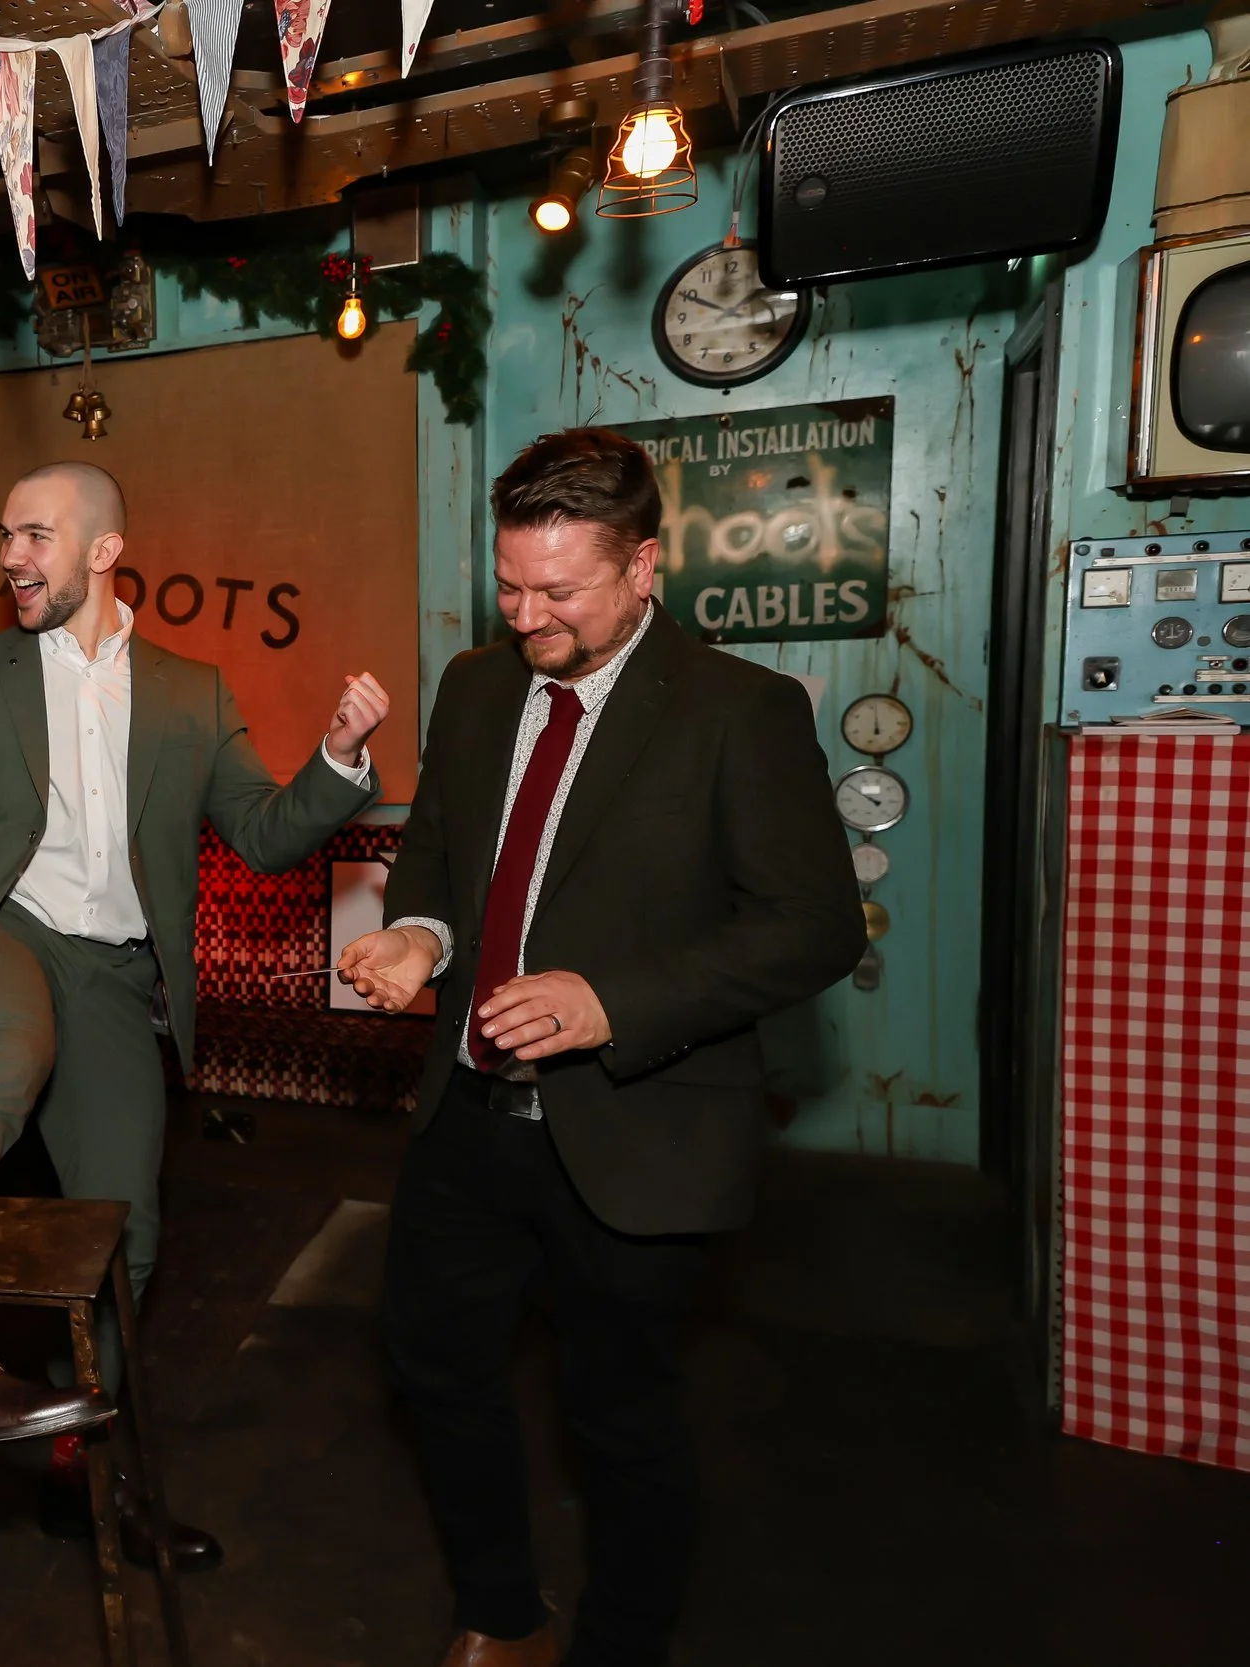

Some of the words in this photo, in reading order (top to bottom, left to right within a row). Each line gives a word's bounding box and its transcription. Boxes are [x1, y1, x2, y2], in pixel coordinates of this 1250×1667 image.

[724, 261, 738, 274] 12
[52, 268, 89, 287] ON
[702, 271, 712, 283] 11
[56, 286, 97, 303] AIR
[678, 312, 686, 324] 9
[683, 334, 691, 346] 8
[701, 348, 709, 359] 7
[748, 342, 757, 353] 5
[723, 352, 733, 363] 6
[632, 434, 708, 466] RICAL
[717, 417, 875, 460] INSTALLATION
[709, 464, 731, 477] BY
[694, 580, 869, 630] CABLES
